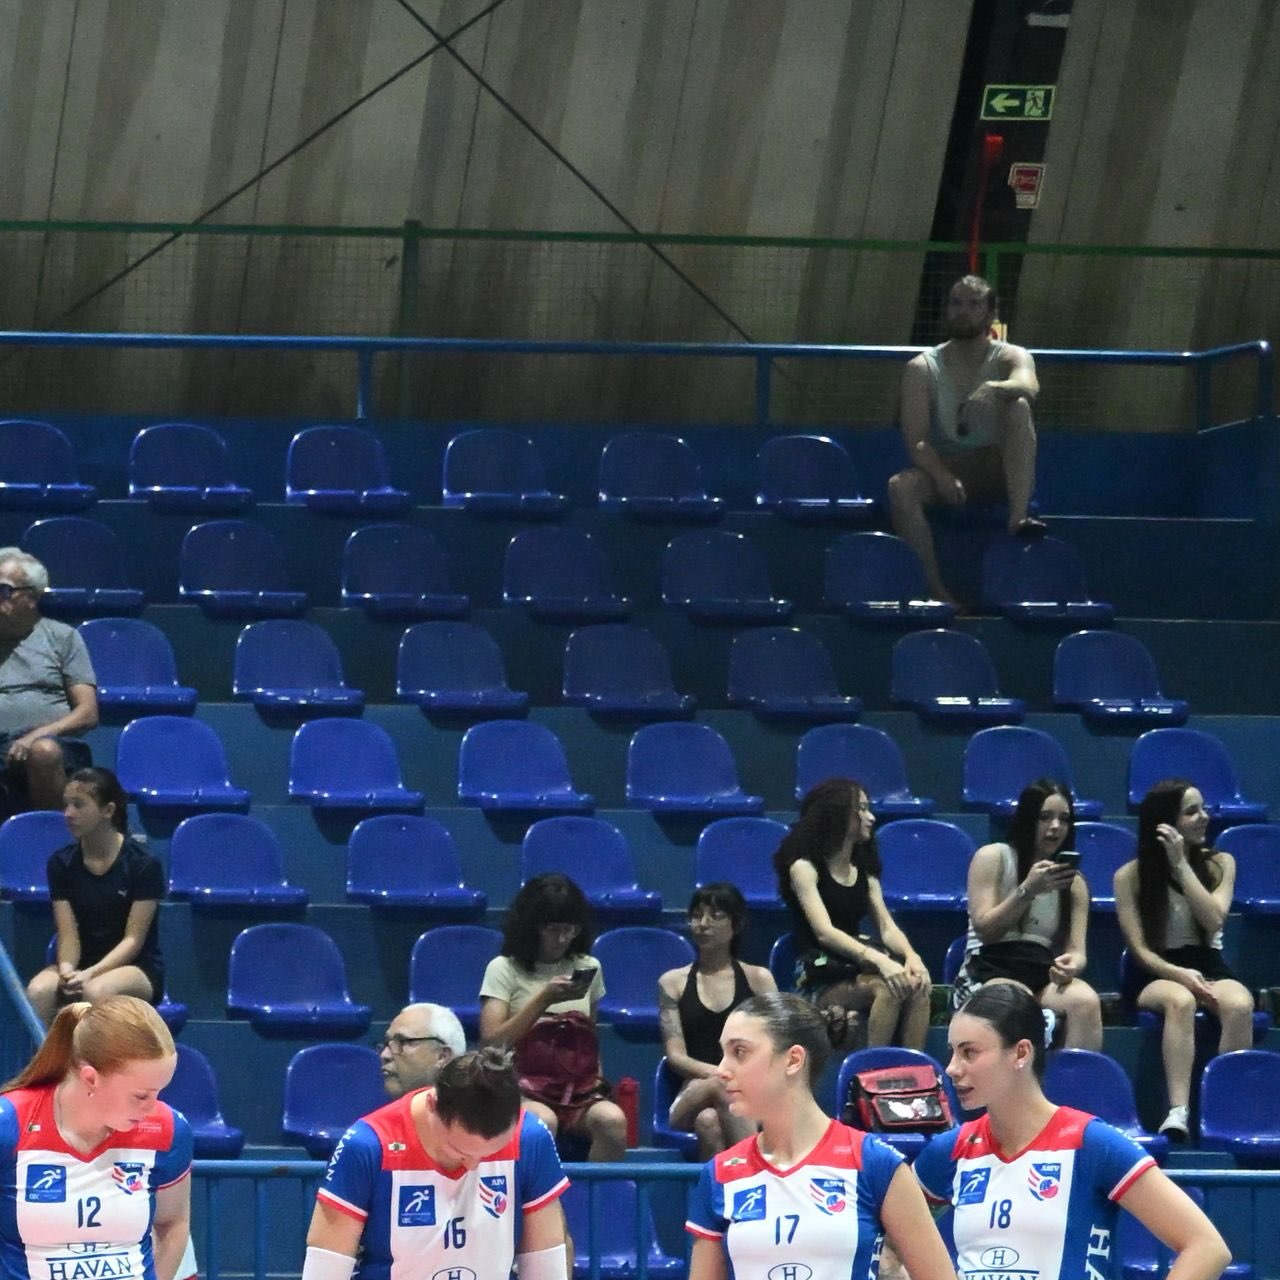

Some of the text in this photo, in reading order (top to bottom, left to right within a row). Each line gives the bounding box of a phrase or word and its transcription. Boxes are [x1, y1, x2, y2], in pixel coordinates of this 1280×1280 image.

[325, 1128, 357, 1182] HAVAN
[77, 1196, 102, 1229] 12
[989, 1198, 1013, 1230] 18
[443, 1216, 467, 1250] 16
[775, 1214, 800, 1246] 17
[992, 1250, 1005, 1266] H
